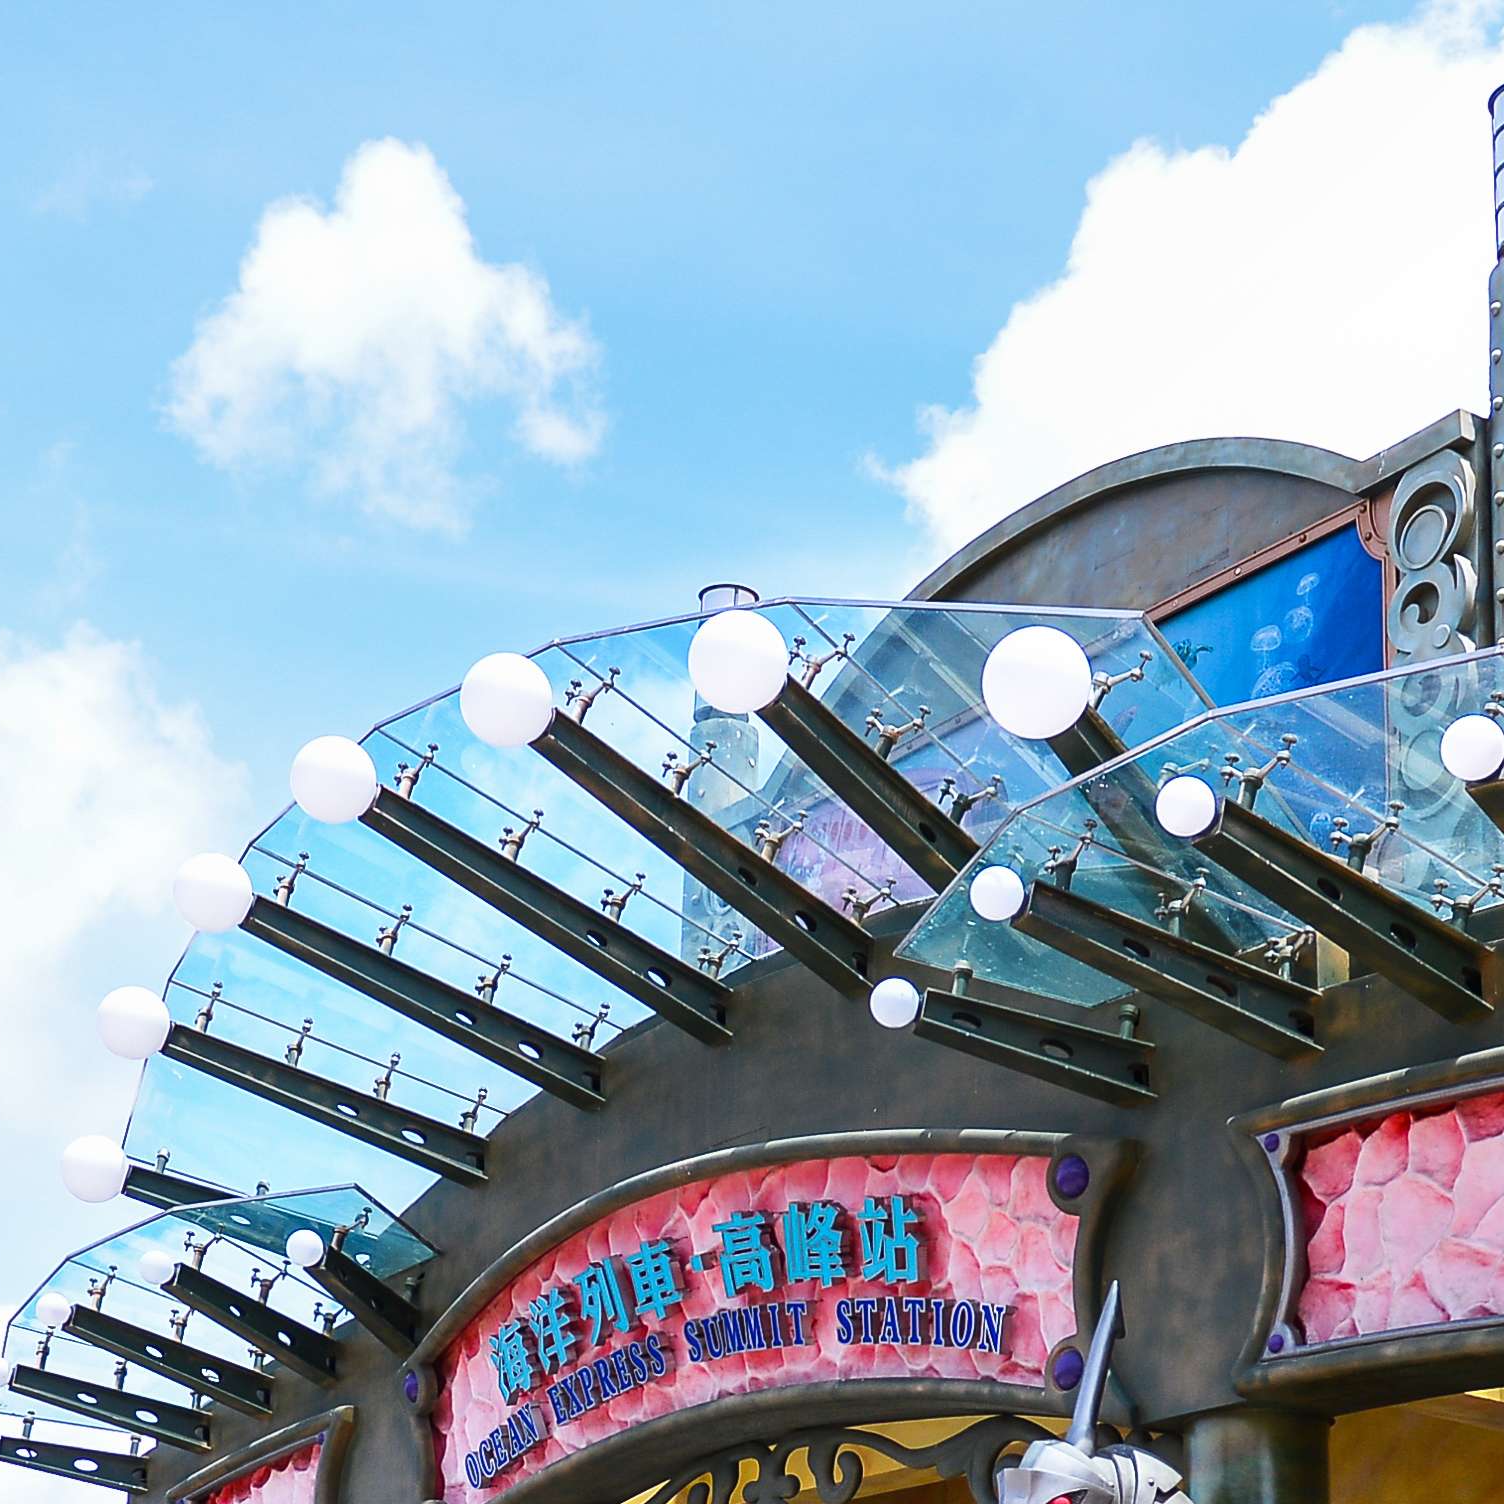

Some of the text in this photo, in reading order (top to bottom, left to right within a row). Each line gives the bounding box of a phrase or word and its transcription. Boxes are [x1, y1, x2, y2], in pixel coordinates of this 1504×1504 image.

[465, 1296, 1005, 1488] OCEAN EXPRESS SUMMIT STATION
